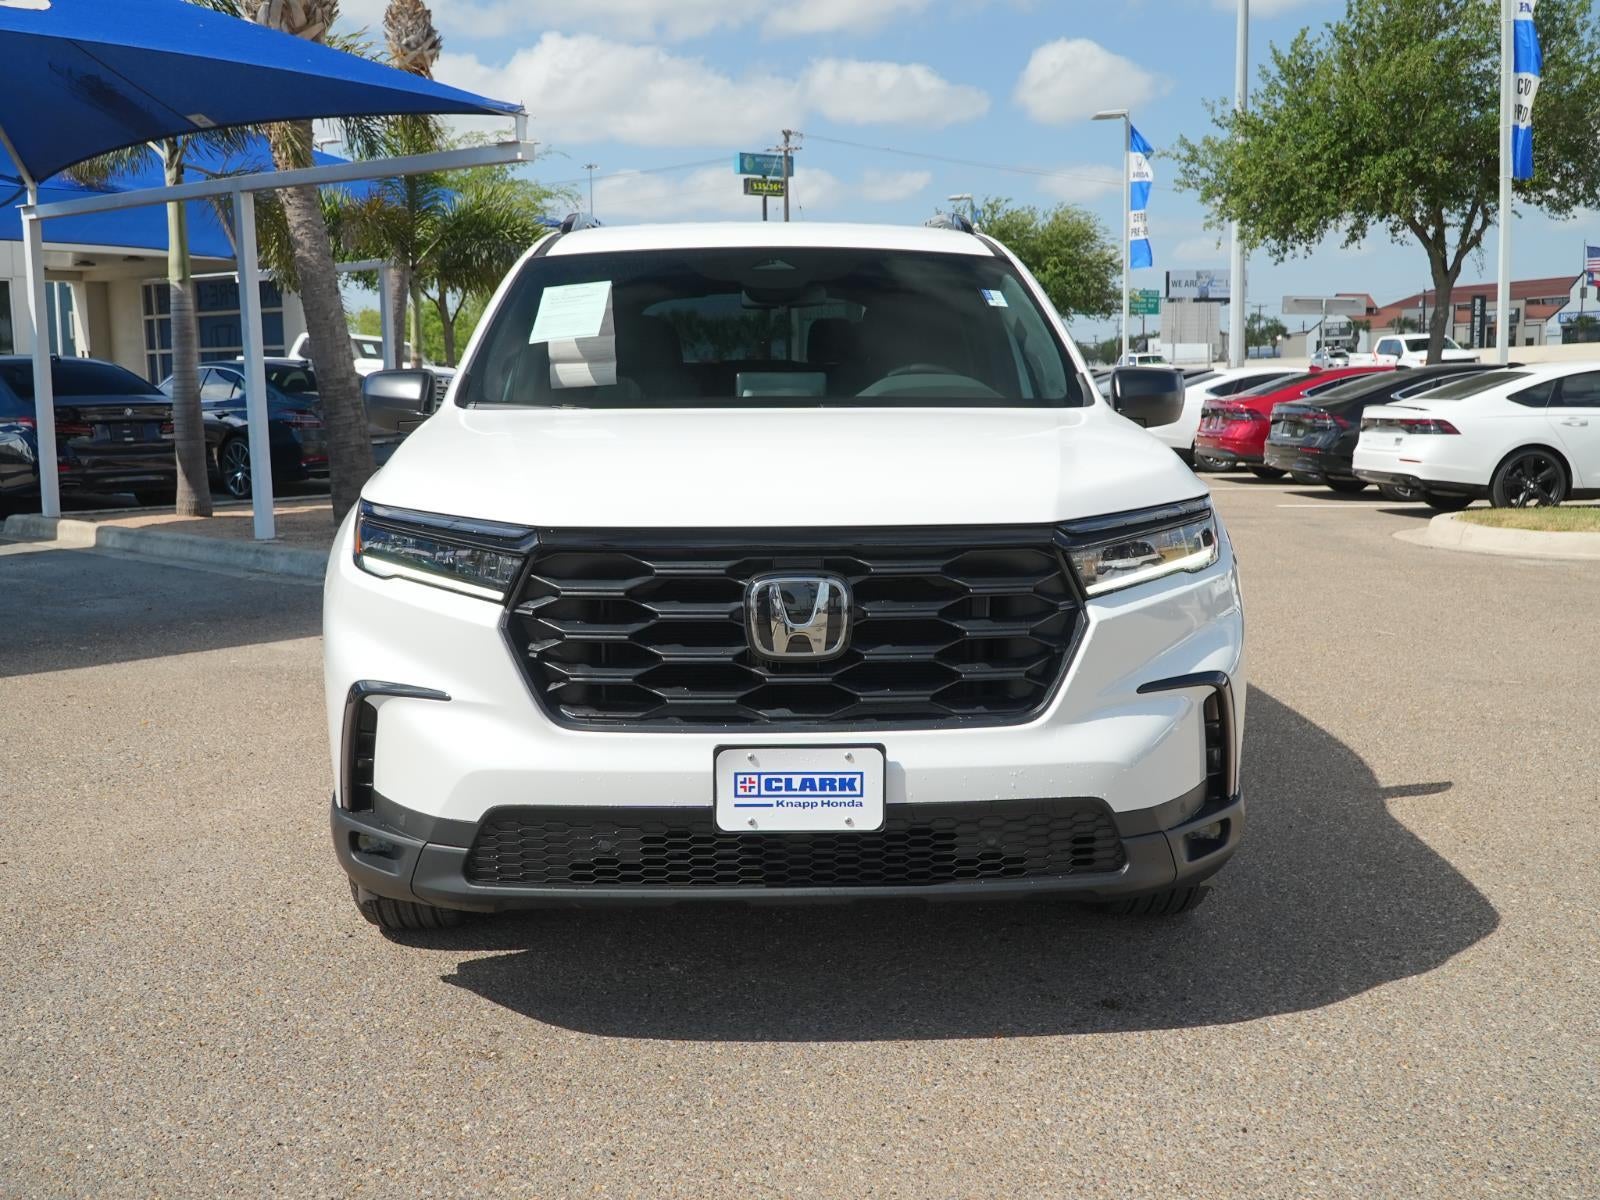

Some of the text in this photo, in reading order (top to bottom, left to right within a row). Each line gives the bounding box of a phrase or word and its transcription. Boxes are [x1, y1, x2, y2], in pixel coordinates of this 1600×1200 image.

[1171, 280, 1199, 288] WE ARE
[764, 777, 857, 792] CLARK
[776, 800, 863, 809] Knapp Honda
